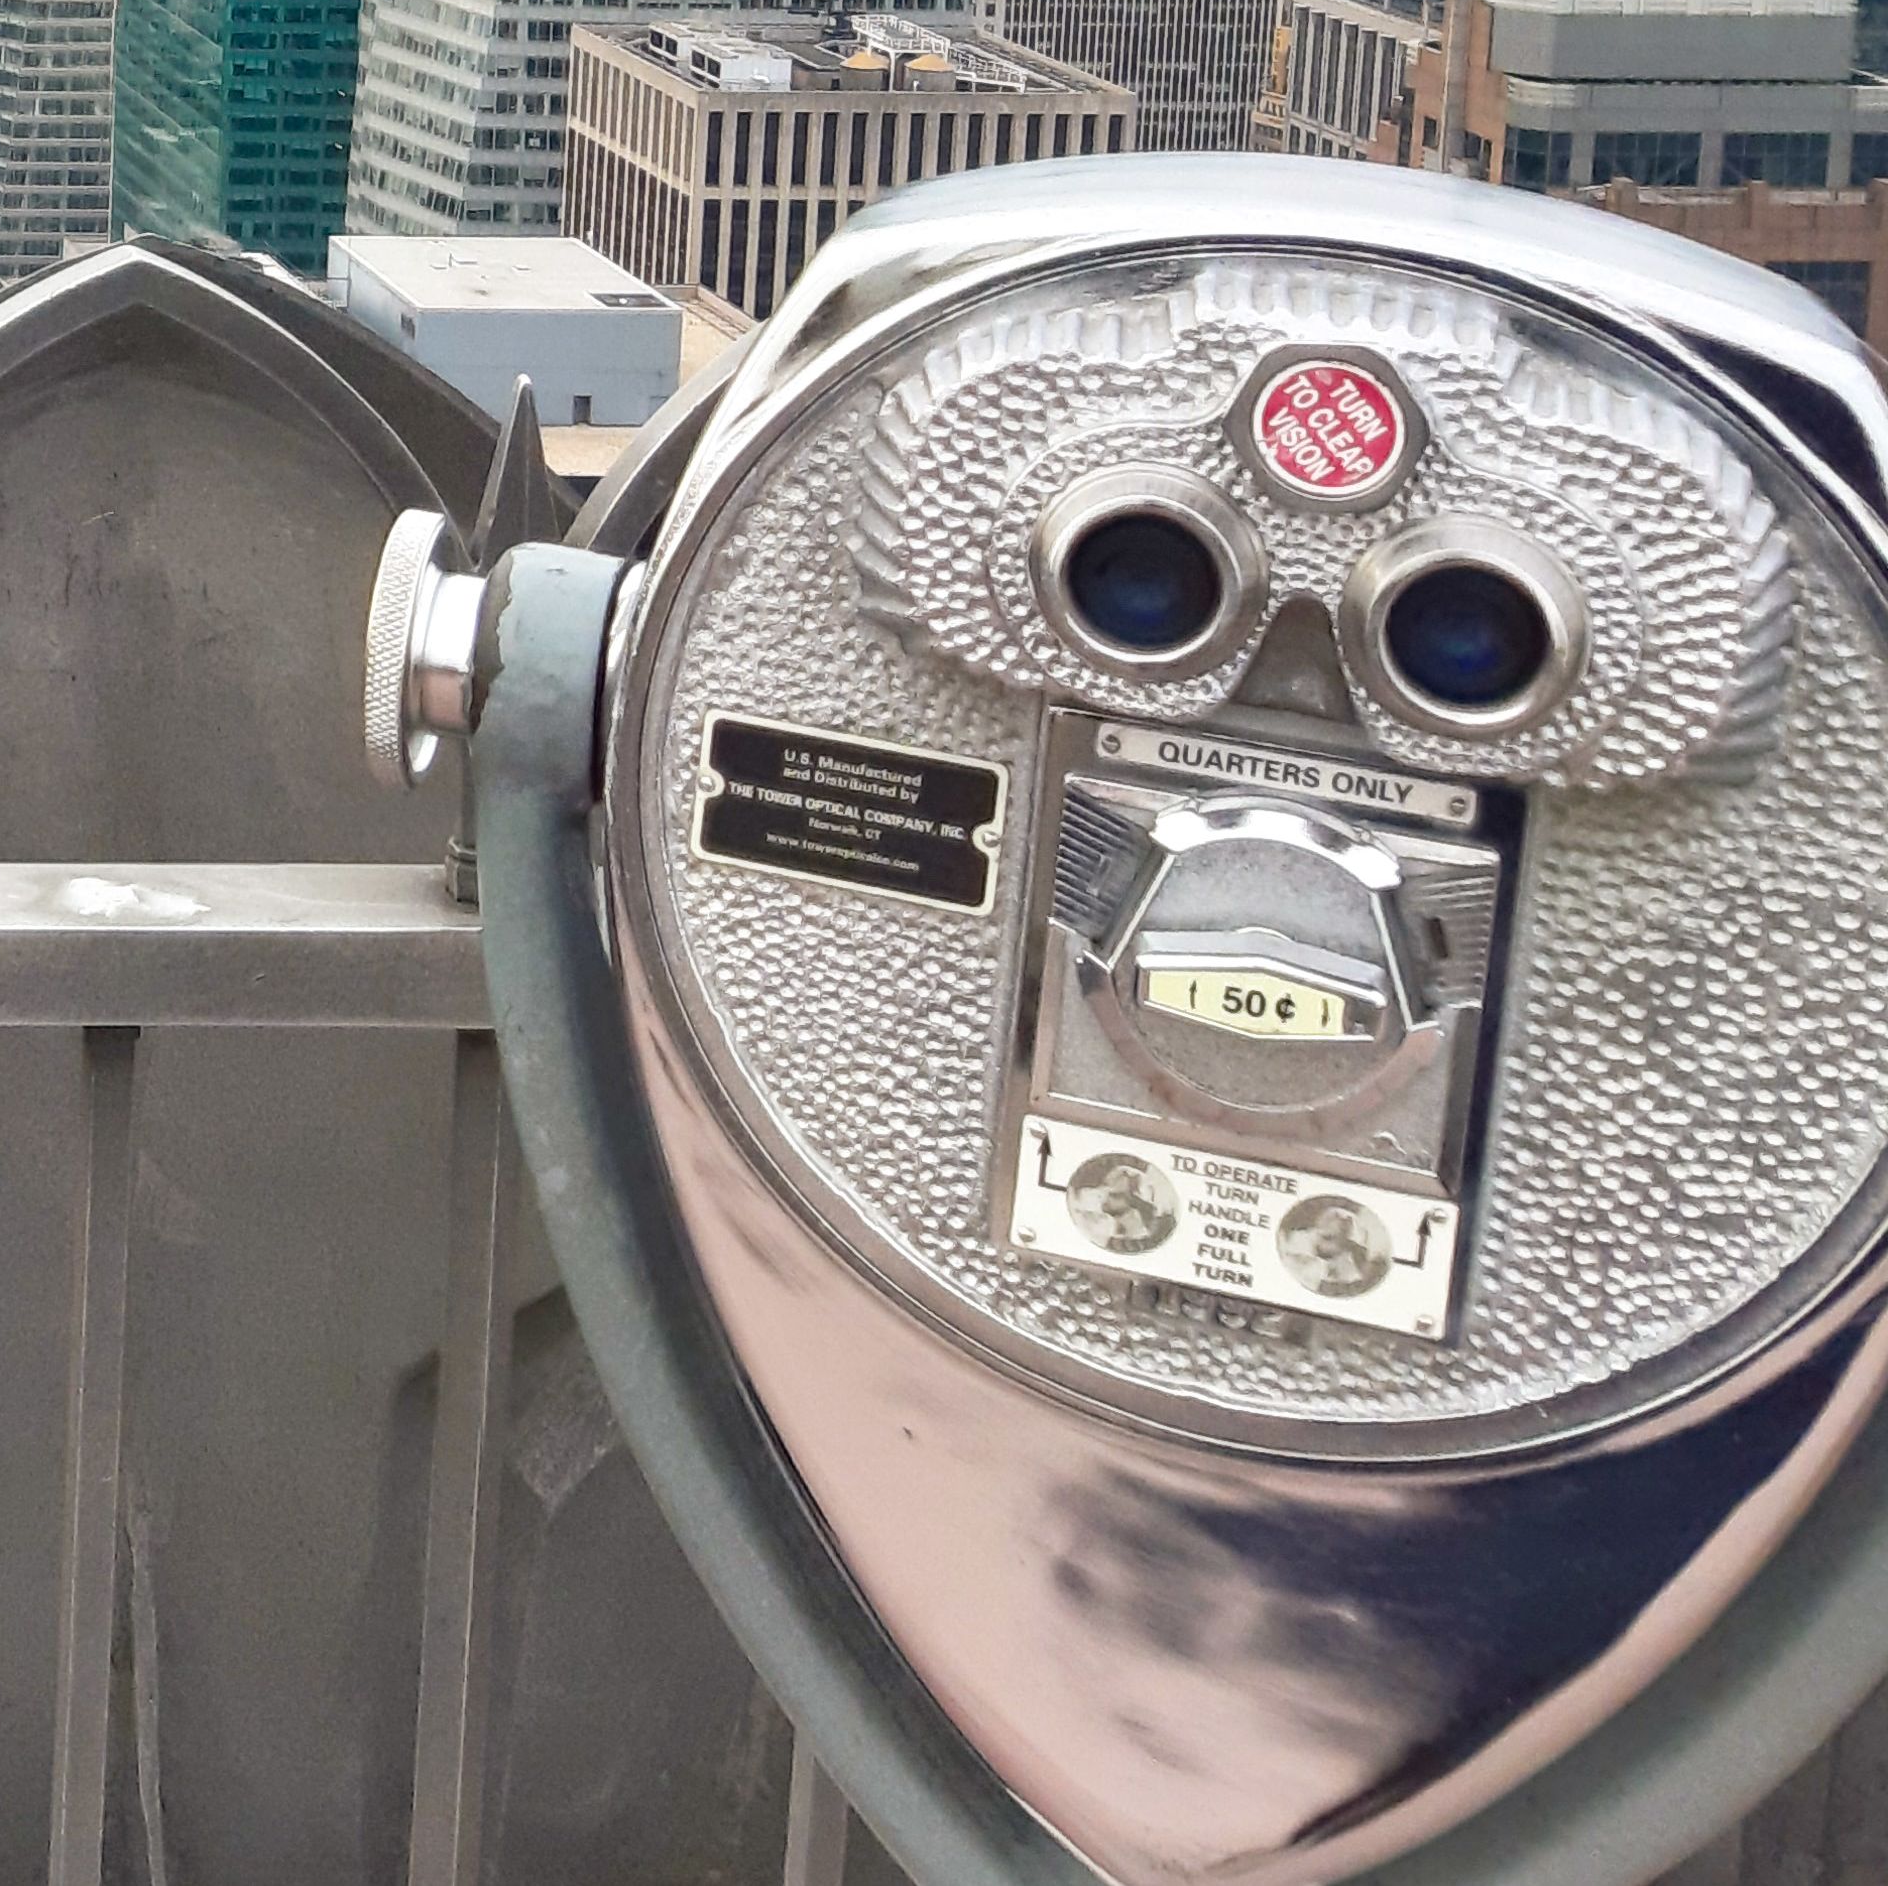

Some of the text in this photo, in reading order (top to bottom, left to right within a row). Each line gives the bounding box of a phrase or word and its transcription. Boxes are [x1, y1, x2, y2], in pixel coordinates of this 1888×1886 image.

[1283, 374, 1375, 474] TO CLEAR
[1329, 378, 1389, 442] TURN
[1268, 407, 1336, 481] VISION
[783, 767, 920, 804] and Distributed by
[784, 748, 922, 787] U.S. Manufactured
[1157, 740, 1415, 804] QUARTERS ONLY
[729, 780, 754, 798] THE
[756, 787, 803, 808] TOWER
[805, 797, 861, 820] OPTICAL
[863, 809, 938, 836] COMPANY,
[864, 828, 882, 840] CT
[1171, 1154, 1298, 1195] TO OPERATE
[1205, 1181, 1260, 1205] TURN
[1188, 1200, 1271, 1230] HANDLE
[1204, 1223, 1250, 1245] ONE
[1197, 1243, 1252, 1266] FULL
[1192, 1262, 1254, 1288] TURN
